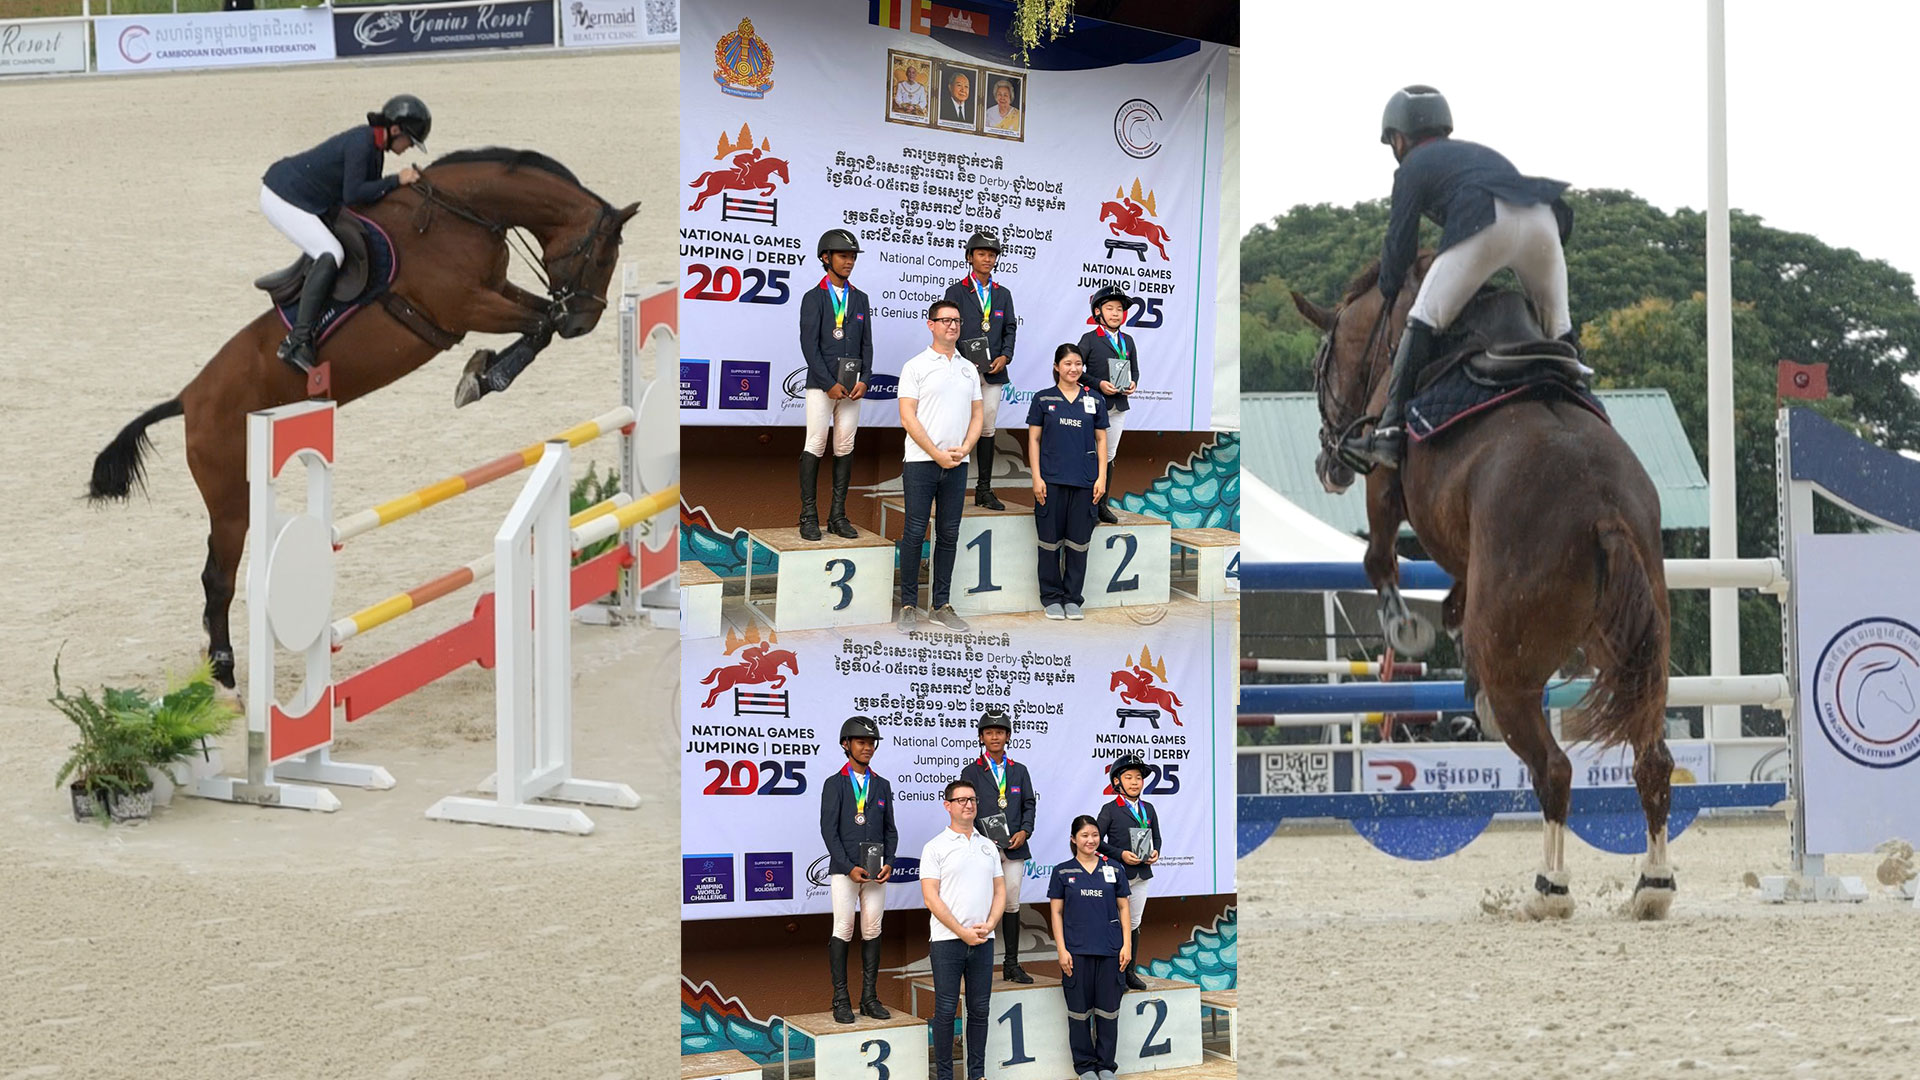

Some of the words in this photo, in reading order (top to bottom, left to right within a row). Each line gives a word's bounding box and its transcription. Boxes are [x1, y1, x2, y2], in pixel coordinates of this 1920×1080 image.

[408, 8, 469, 42] Genius
[477, 3, 534, 31] Resort
[572, 7, 636, 31] Mermaid
[430, 34, 475, 43] EMPOWERING
[476, 32, 498, 41] YOUNG
[500, 31, 524, 40] RIDERS
[573, 32, 606, 42] BEAUTY
[608, 30, 637, 40] CLINIC
[156, 49, 210, 60] CAMBODIAN
[211, 46, 264, 57] EQUESTRIAN
[264, 43, 316, 54] FEDERATION
[957, 170, 977, 184] និង
[966, 203, 1002, 220] ២៥៦៩
[680, 228, 750, 245] NATIONAL
[753, 234, 801, 249] GAMES
[680, 244, 744, 261] UMPING
[756, 251, 807, 266] DERBY
[880, 252, 924, 266] National
[927, 256, 969, 271] Compet
[1083, 263, 1135, 276] NATIONAL
[1137, 267, 1172, 280] GAMES
[683, 263, 790, 305] 2025
[899, 272, 945, 287] Jumping
[948, 277, 961, 287] an
[882, 290, 896, 299] on
[899, 289, 941, 302] October
[1139, 282, 1175, 295] DERBY
[881, 307, 919, 320] Genius
[1059, 417, 1082, 428] NURSE
[966, 529, 1002, 595] 1
[1106, 532, 1139, 594] 2
[825, 558, 856, 611] 3
[965, 649, 984, 662] និង
[975, 682, 1011, 697] ២៥៦៩
[692, 725, 764, 738] NATIONAL
[767, 727, 815, 740] GAMES
[1824, 702, 1851, 745] CAMBODIAN
[1853, 743, 1896, 757] EQUESTRIAN
[893, 735, 938, 748] National
[1007, 738, 1032, 750] 2025
[1096, 734, 1149, 745] NATIONAL
[1151, 735, 1186, 746] GAMES
[686, 741, 760, 755] JUMPING
[771, 743, 820, 756] DERBY
[1153, 749, 1191, 761] DERBY
[914, 754, 960, 768] Jumping
[963, 757, 977, 767] an
[703, 759, 807, 796] 2025
[898, 773, 912, 783] on
[915, 772, 956, 783] October
[898, 790, 935, 801] Genius
[690, 894, 728, 902] CHALLENGE
[1080, 889, 1103, 898] NURSE
[997, 1002, 1037, 1067] 1
[1136, 998, 1172, 1059] 2
[860, 1038, 891, 1080] 3
